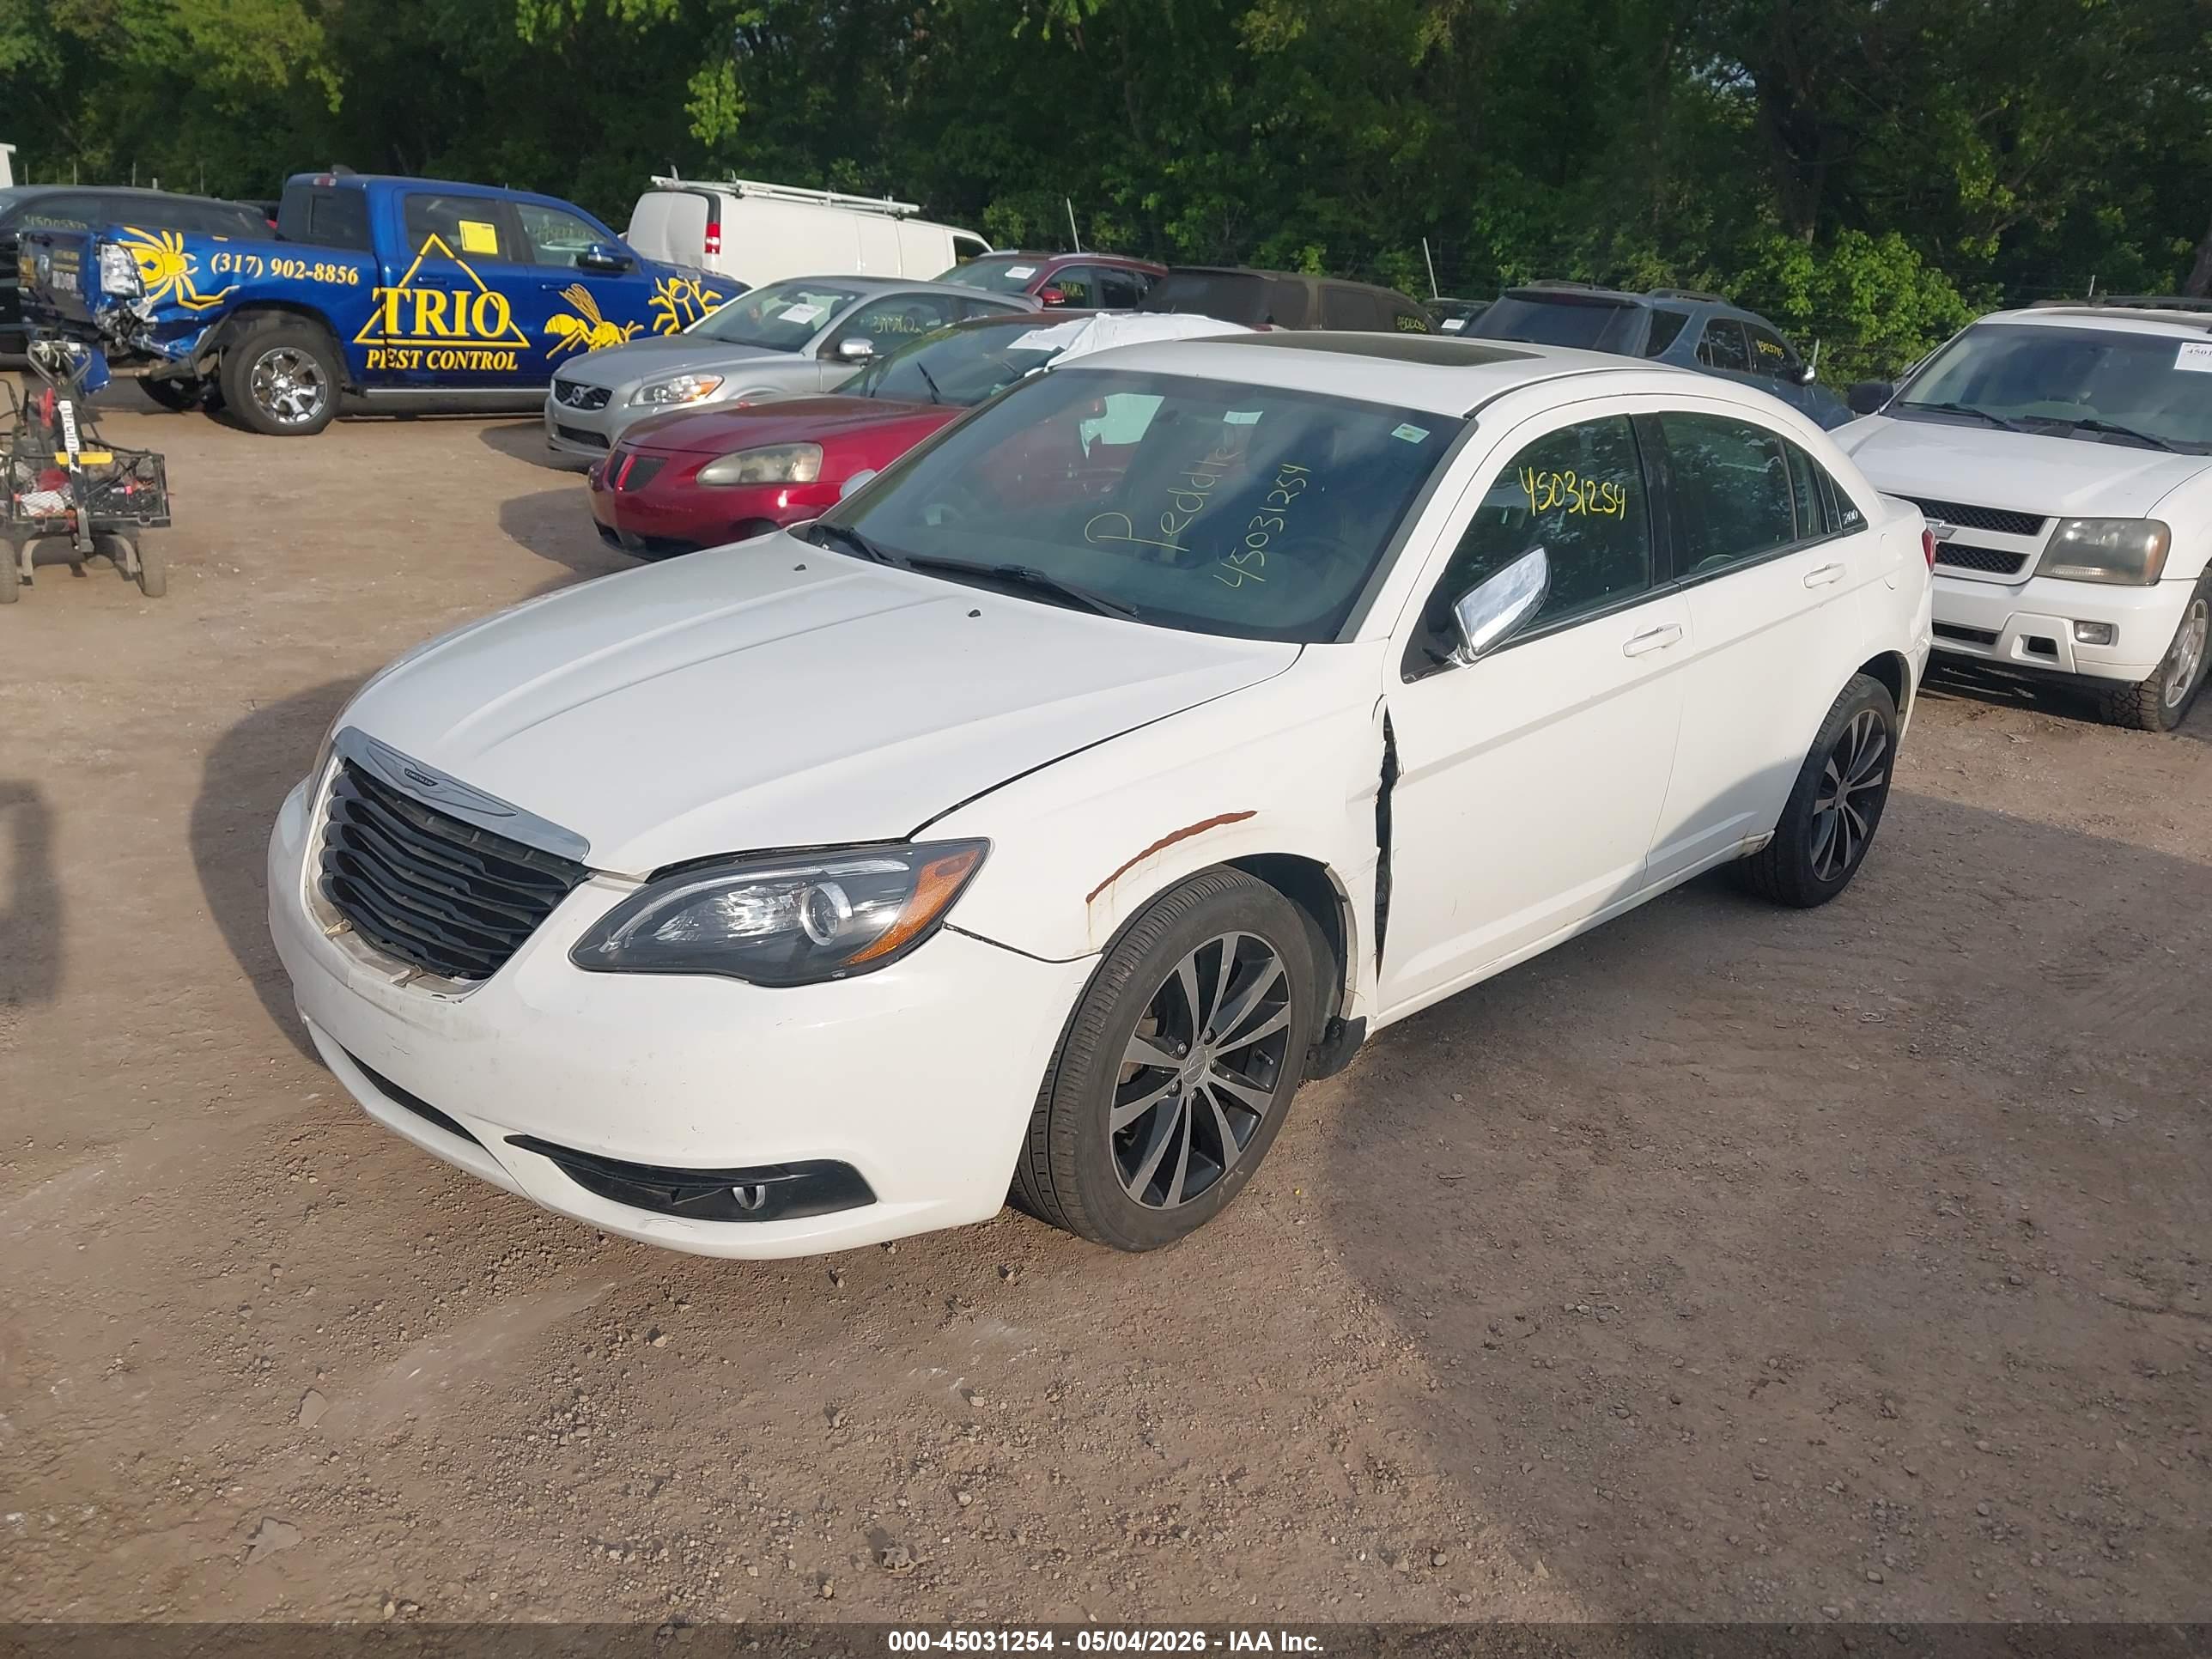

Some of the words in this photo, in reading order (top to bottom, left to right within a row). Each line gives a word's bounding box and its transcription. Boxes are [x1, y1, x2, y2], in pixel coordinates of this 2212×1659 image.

[210, 252, 264, 278] (317)
[270, 257, 359, 286] 902-8856
[372, 286, 511, 338] TRIO
[366, 348, 423, 370] PEST
[426, 349, 519, 371] CONTROL
[1518, 466, 1626, 521] 45031254
[1212, 462, 1312, 588] 45031254
